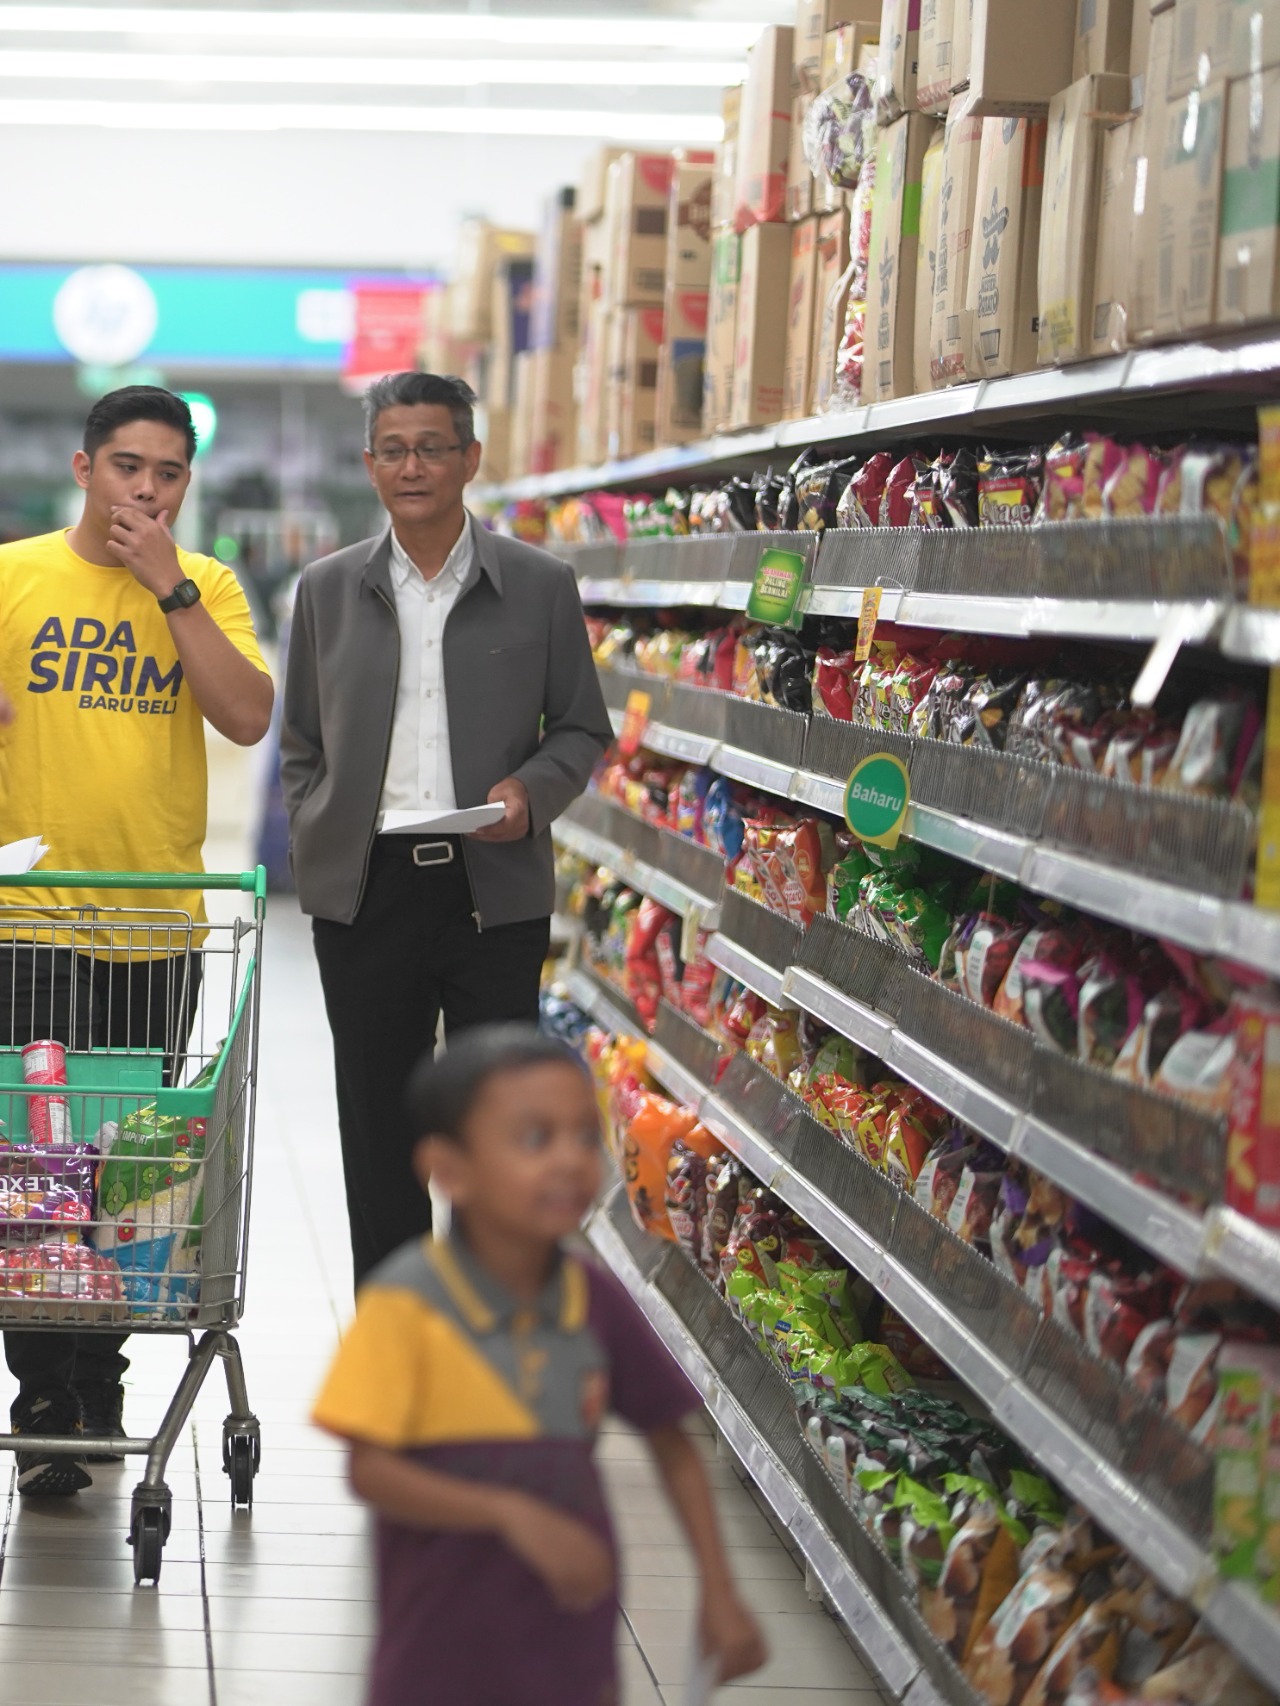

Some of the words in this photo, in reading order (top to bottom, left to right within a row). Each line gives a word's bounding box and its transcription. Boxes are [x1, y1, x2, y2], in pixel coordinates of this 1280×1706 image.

[31, 617, 137, 653] ADA
[27, 651, 184, 697] SIRIM
[78, 695, 134, 713] BARU
[137, 700, 177, 714] BELI
[851, 782, 902, 811] Baharu
